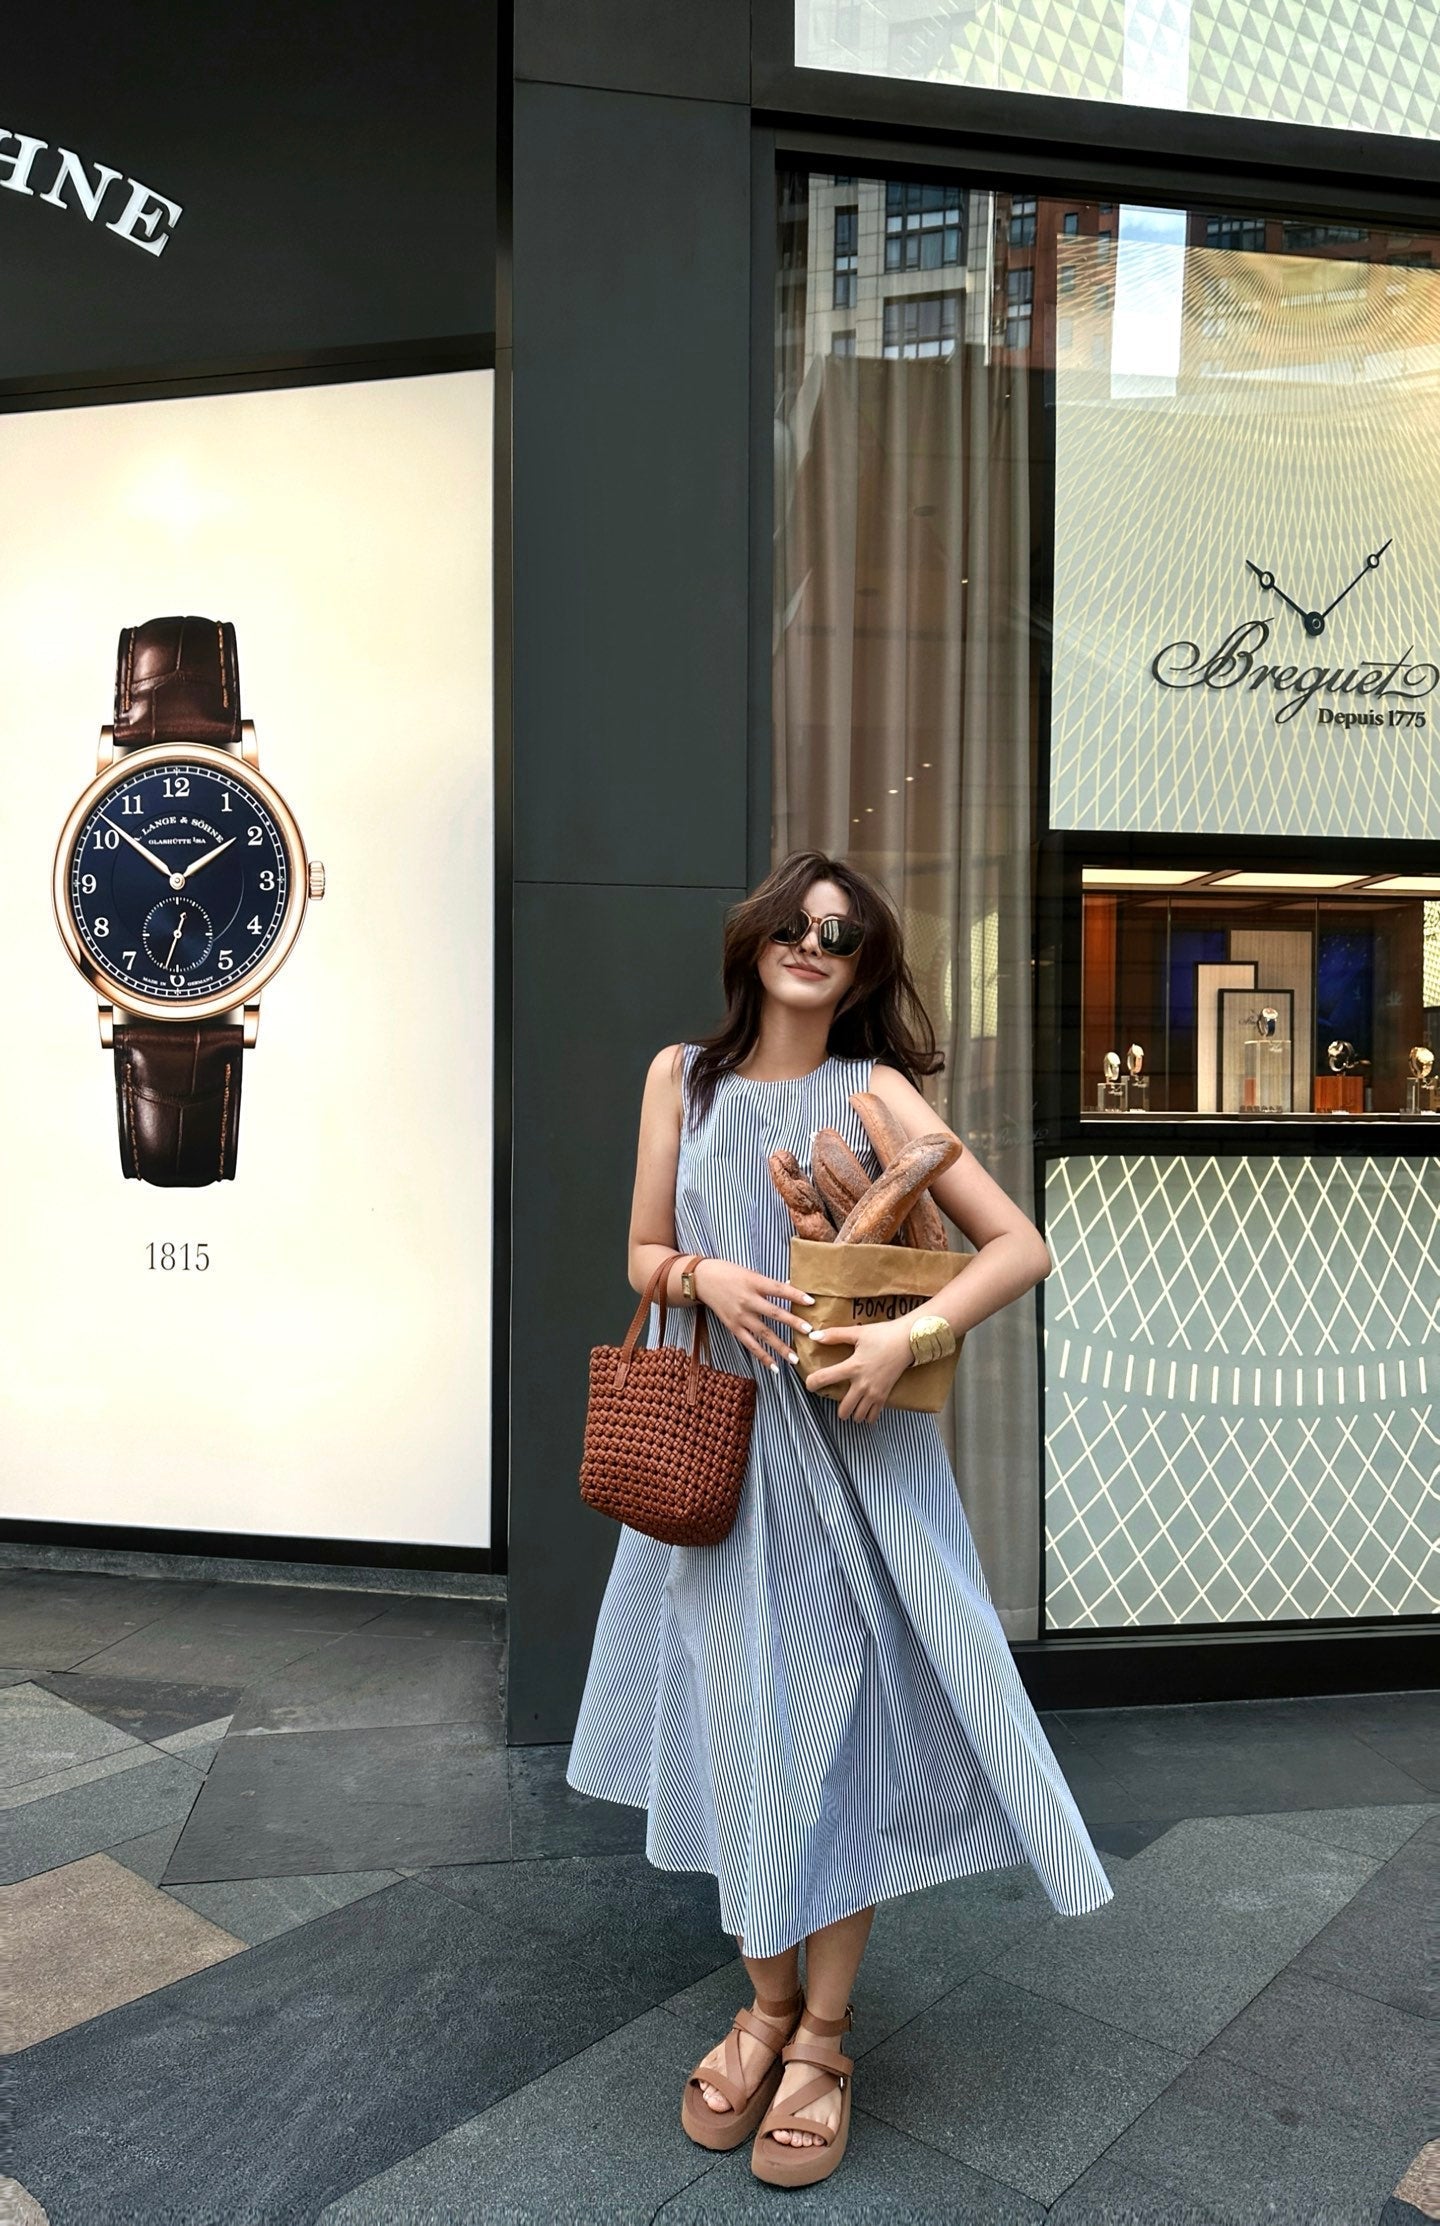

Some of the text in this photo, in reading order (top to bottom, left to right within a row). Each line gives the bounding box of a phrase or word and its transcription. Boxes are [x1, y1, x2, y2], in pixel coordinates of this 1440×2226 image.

[1151, 617, 1440, 724] Breguet
[1317, 708, 1427, 730] Depuis 1775
[162, 777, 190, 798] 12
[121, 794, 144, 815] 11
[221, 792, 233, 812] 1
[92, 829, 120, 850] 10
[141, 816, 224, 844] LANGE & SÖHNE
[247, 825, 263, 846] 2
[81, 873, 97, 894] 9
[259, 870, 275, 891] 3
[93, 916, 110, 938] 8
[246, 914, 263, 935] 4
[122, 950, 137, 971] 7
[217, 949, 234, 970] 5
[146, 1242, 209, 1272] 1815
[853, 1295, 932, 1320] BONJO
